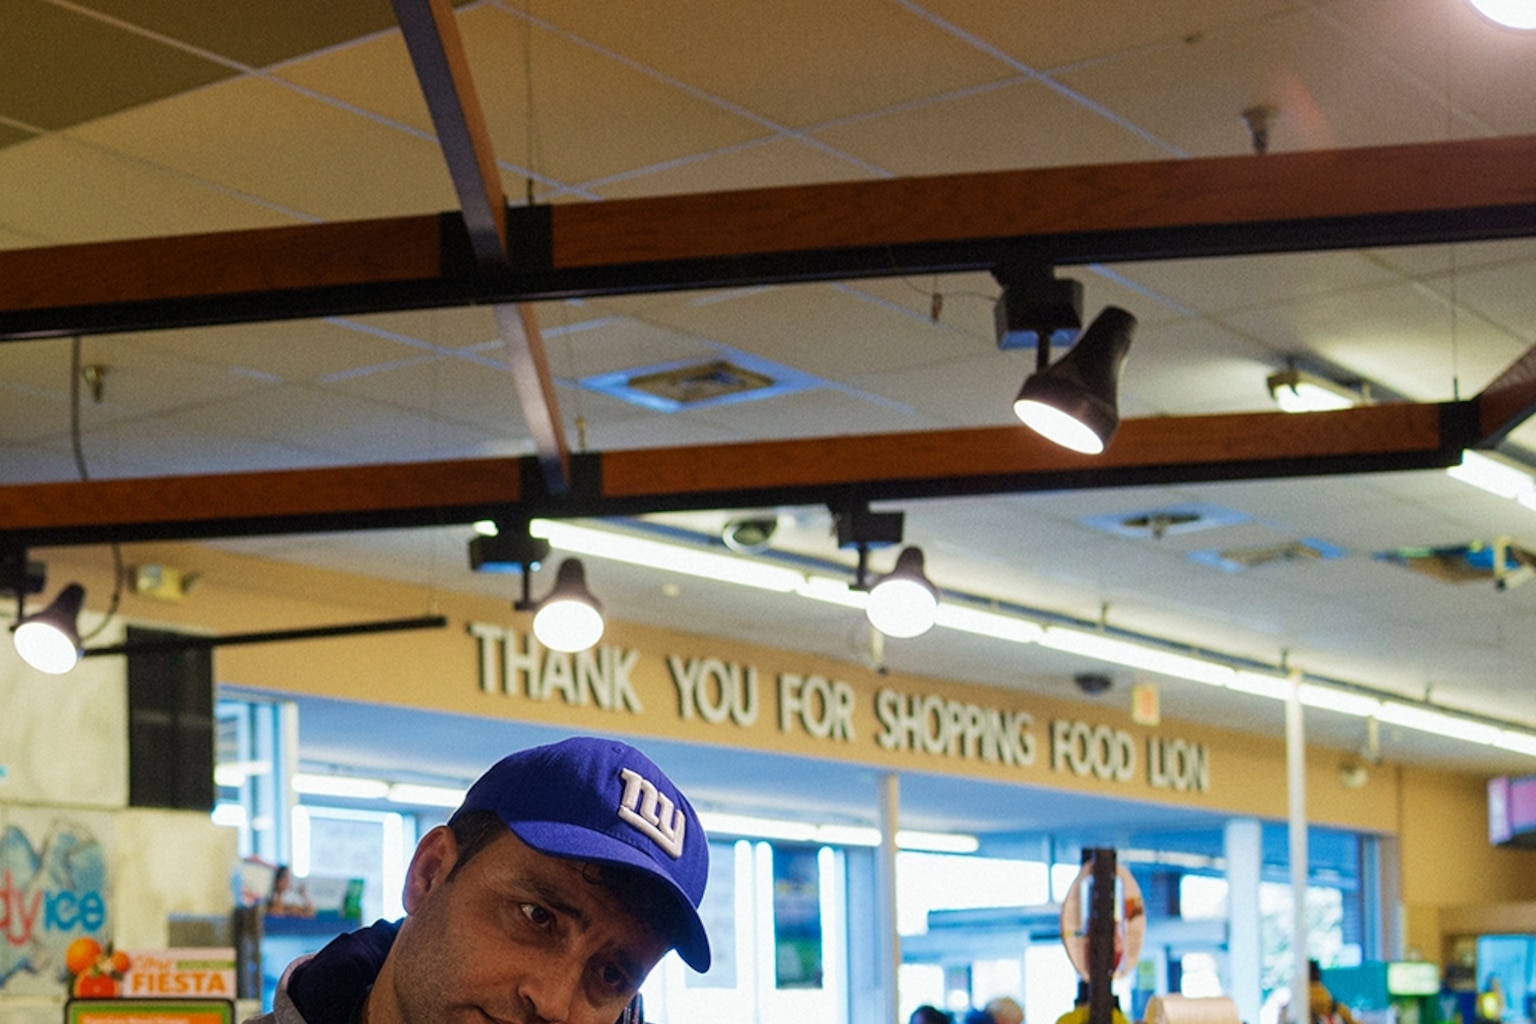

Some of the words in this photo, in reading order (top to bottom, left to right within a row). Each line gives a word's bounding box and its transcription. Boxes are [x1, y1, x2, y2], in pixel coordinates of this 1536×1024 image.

[467, 621, 644, 714] THANK
[667, 653, 760, 728] YOU
[777, 672, 856, 743] FOR
[873, 687, 1038, 768] SHOPPING
[1049, 719, 1138, 782] FOOD
[1146, 735, 1210, 793] LION
[132, 973, 227, 993] FIESTA
